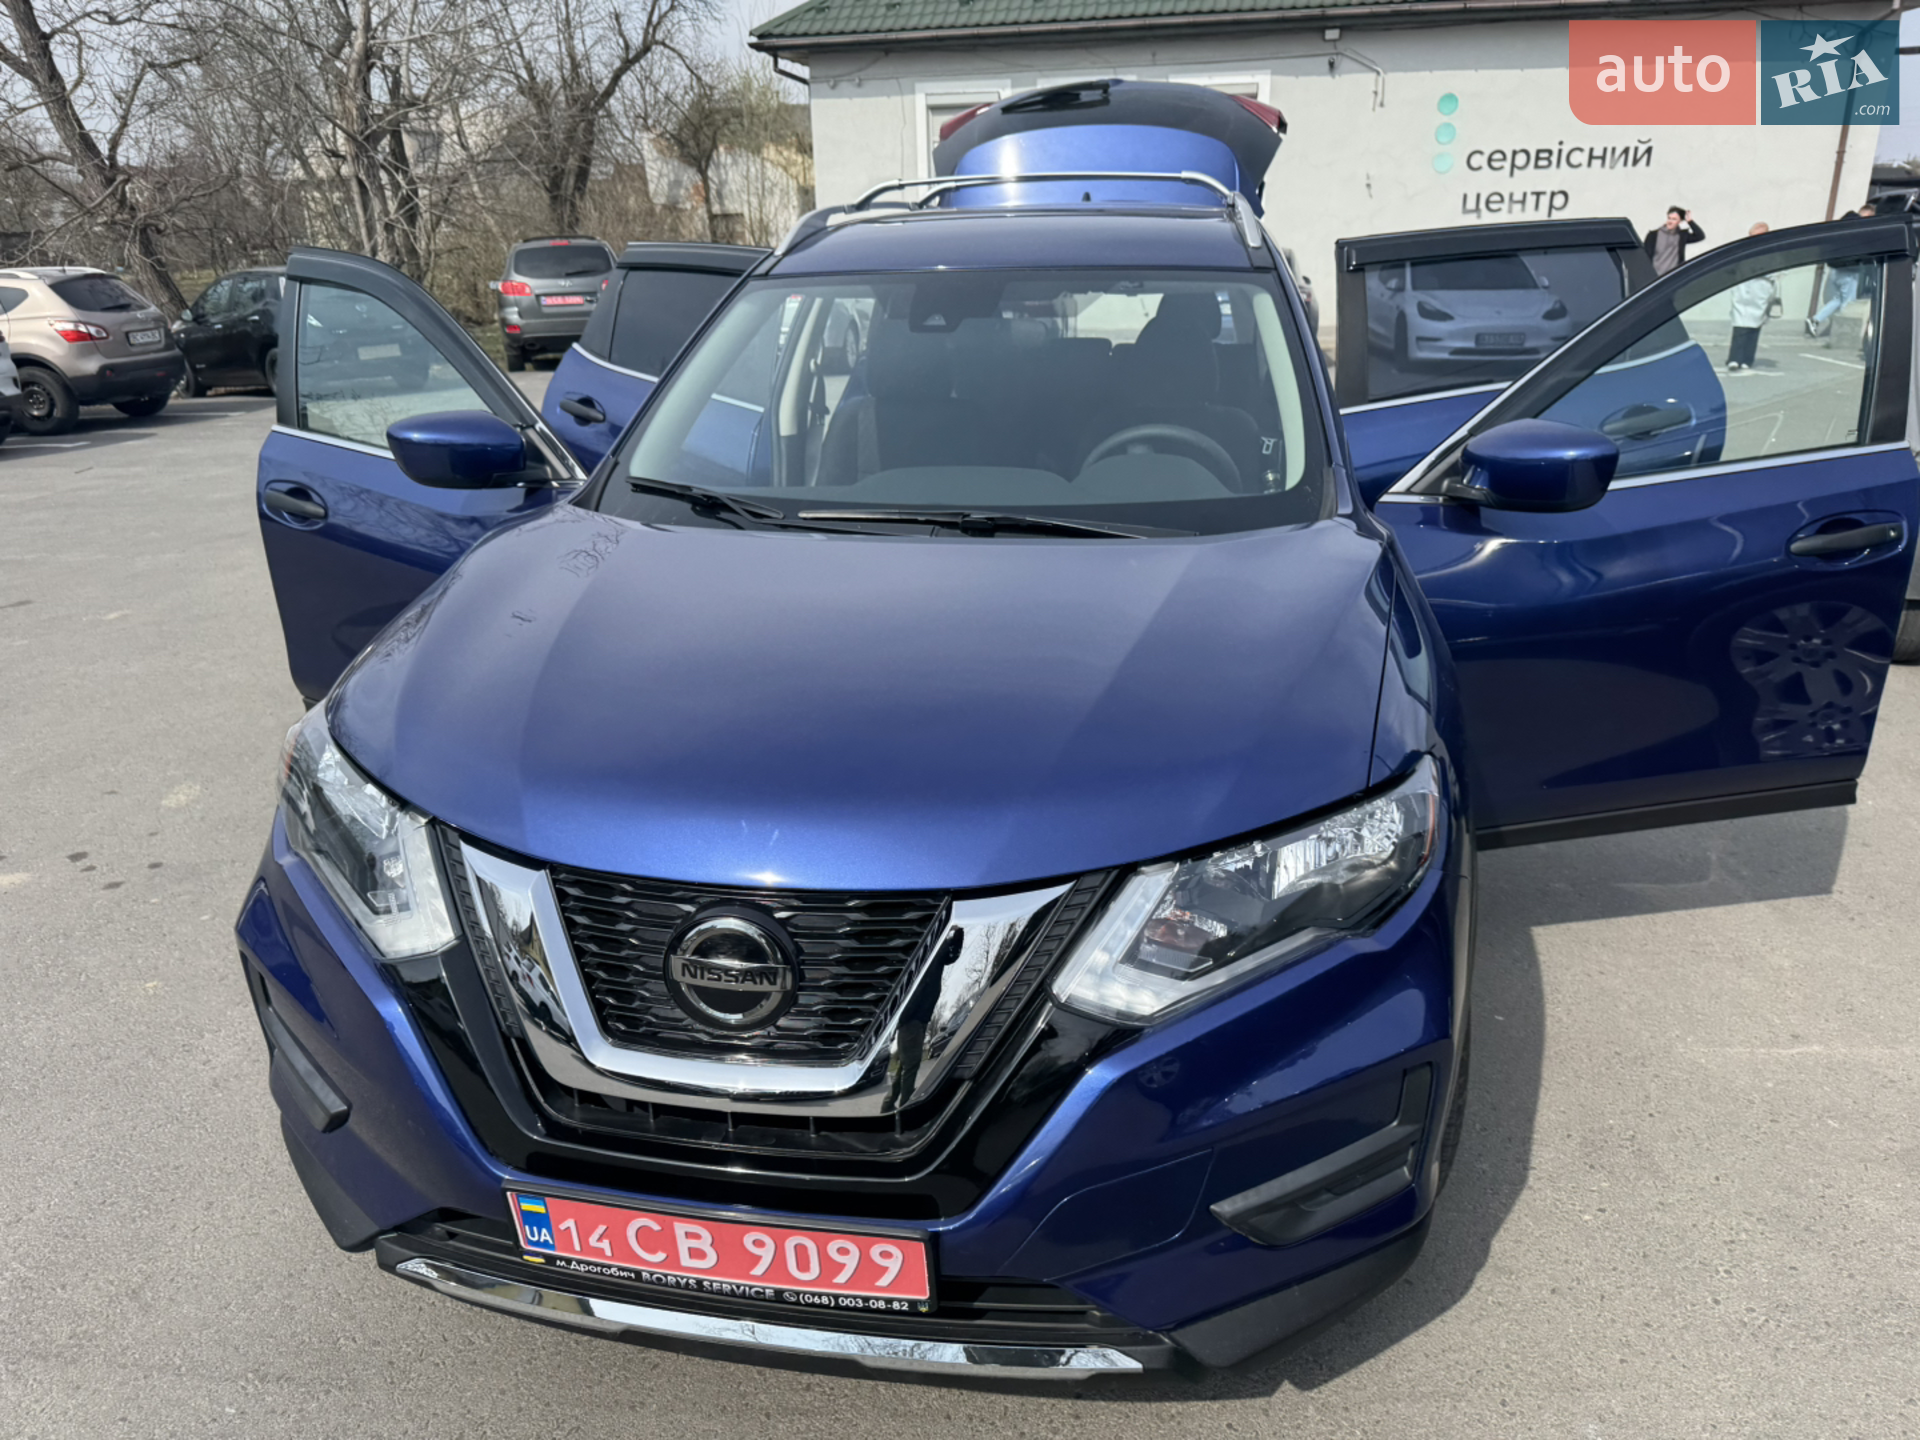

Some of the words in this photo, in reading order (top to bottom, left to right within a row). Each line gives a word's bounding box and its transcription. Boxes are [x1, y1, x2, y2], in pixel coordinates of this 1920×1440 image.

[1466, 138, 1653, 178] сервісний
[1462, 189, 1570, 219] центр
[681, 962, 778, 986] NISSAN
[524, 1225, 553, 1244] UA
[558, 1218, 614, 1257] 14
[626, 1218, 719, 1269] CB
[743, 1232, 904, 1287] 9099
[641, 1271, 698, 1290] BORYS
[702, 1280, 775, 1300] SERVICE
[799, 1293, 835, 1307] (068)
[838, 1297, 909, 1310] 003-08-82
